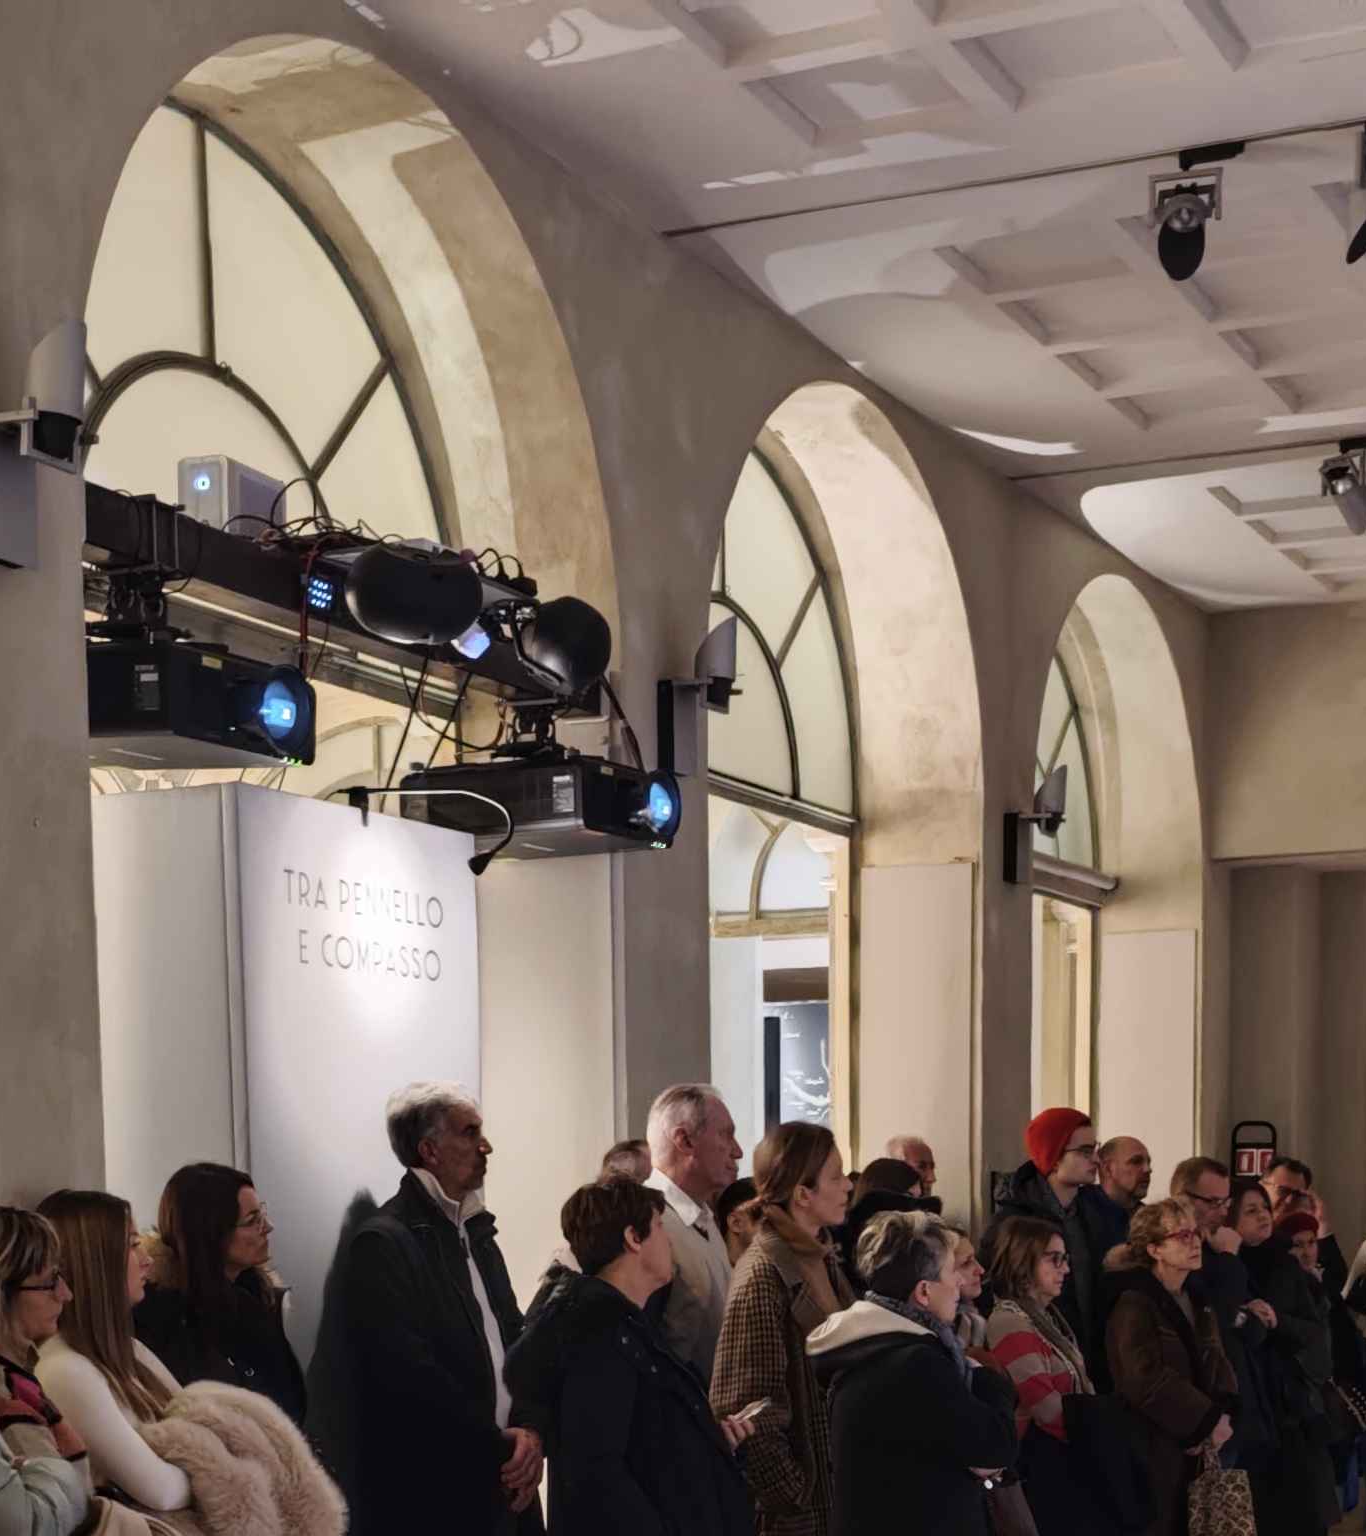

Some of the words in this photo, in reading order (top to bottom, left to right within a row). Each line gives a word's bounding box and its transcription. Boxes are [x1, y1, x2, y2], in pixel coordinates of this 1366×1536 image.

[283, 868, 329, 911] TRA
[338, 879, 444, 929] PENNELLO
[298, 928, 310, 965] E
[320, 933, 442, 982] COMPASSO
